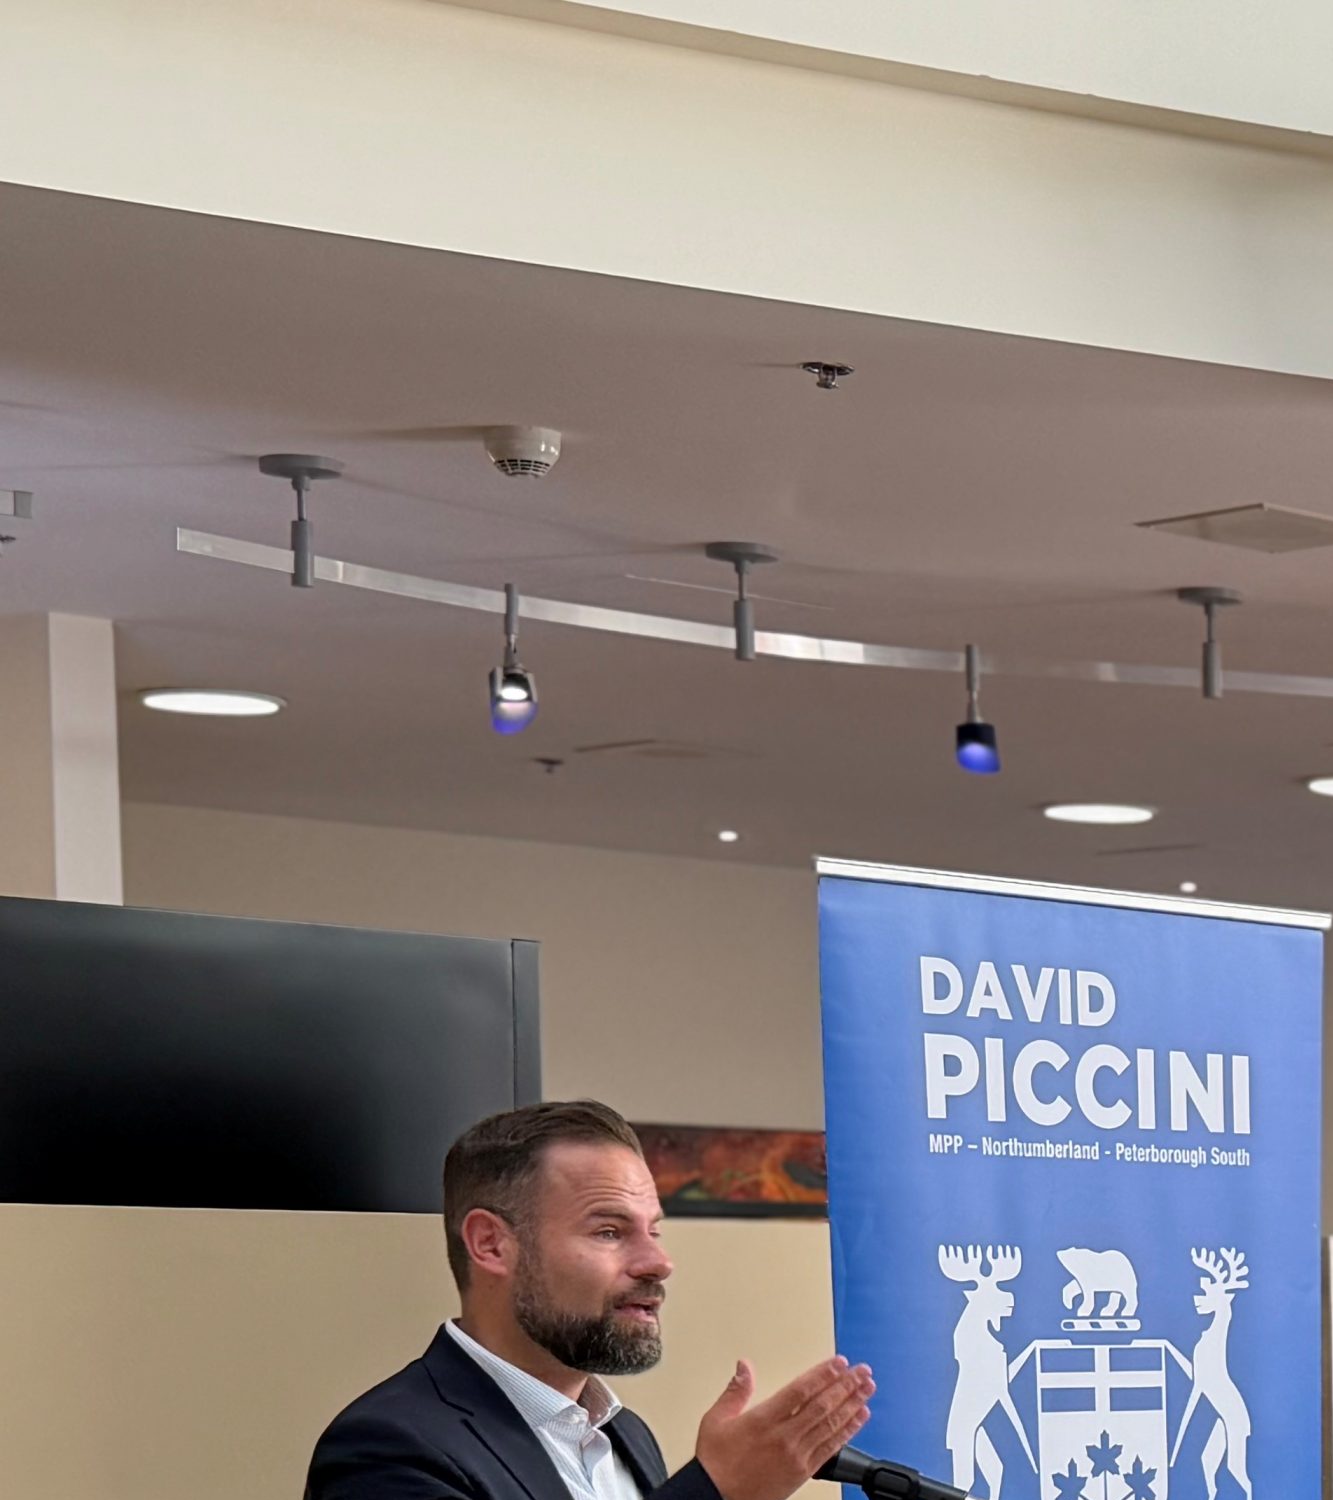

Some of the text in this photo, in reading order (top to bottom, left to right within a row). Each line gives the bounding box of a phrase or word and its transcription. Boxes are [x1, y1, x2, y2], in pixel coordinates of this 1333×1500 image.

[919, 955, 1117, 1027] DAVID
[923, 1032, 1251, 1135] PICCINI
[929, 1133, 963, 1154] MPP
[982, 1136, 1099, 1161] Northumberland
[1116, 1142, 1206, 1169] Peterborough
[1211, 1146, 1250, 1167] South
